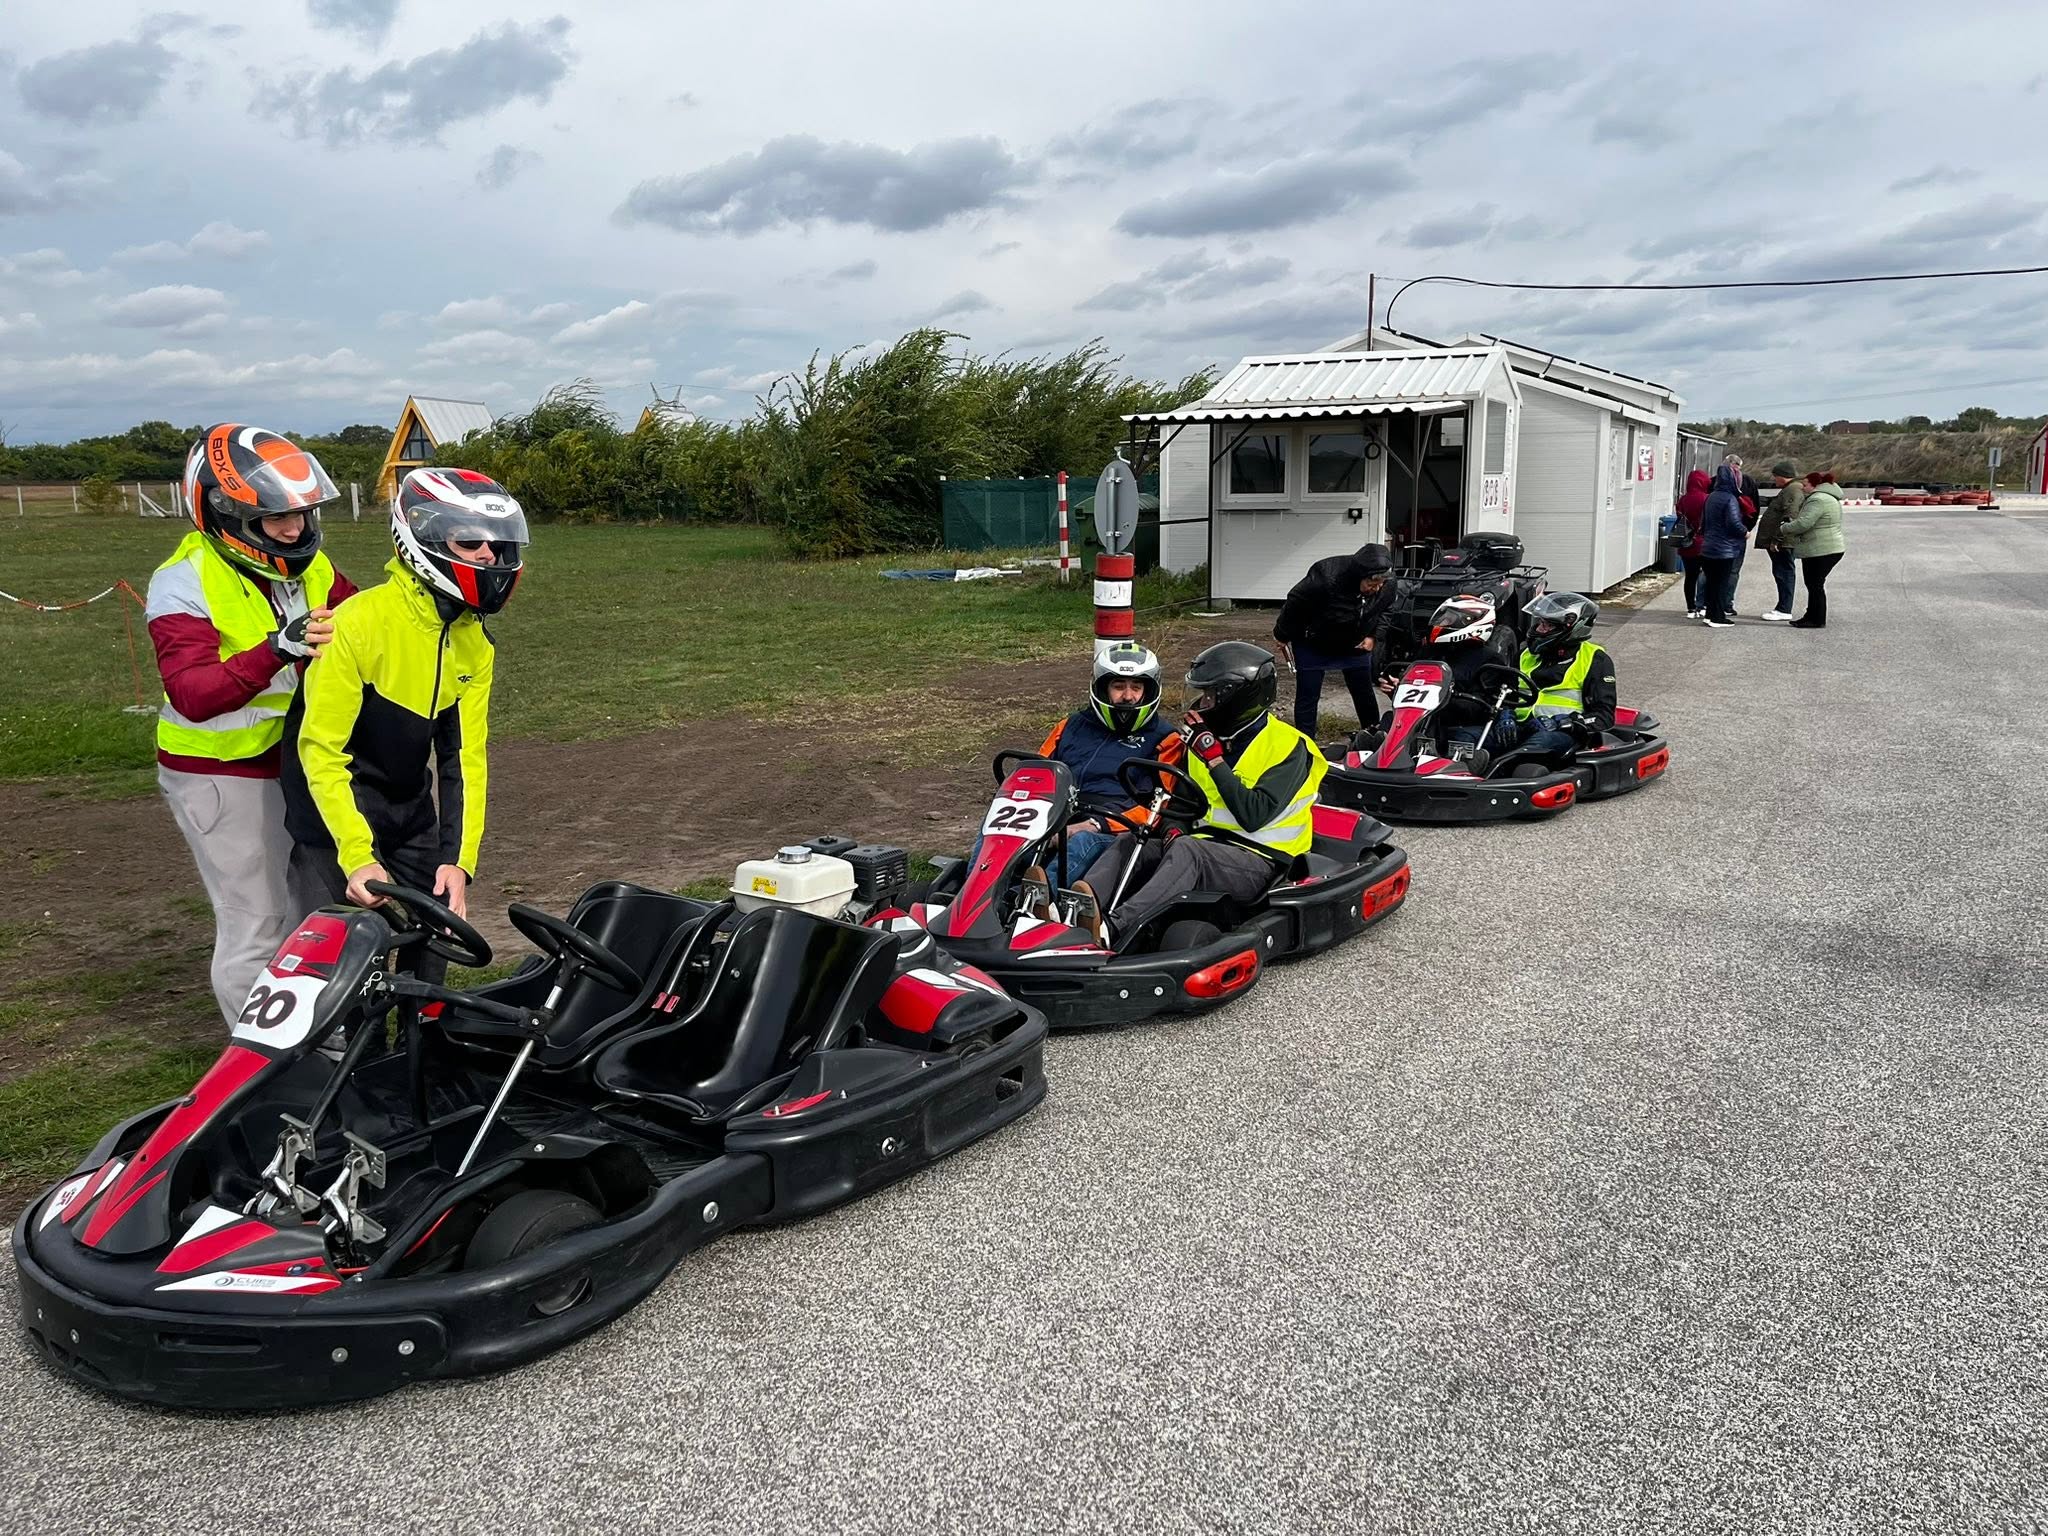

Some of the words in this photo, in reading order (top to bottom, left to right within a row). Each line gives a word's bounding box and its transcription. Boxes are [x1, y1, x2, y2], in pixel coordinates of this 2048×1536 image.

[1401, 689, 1430, 703] 21
[988, 806, 1039, 831] 22
[238, 985, 298, 1030] 20
